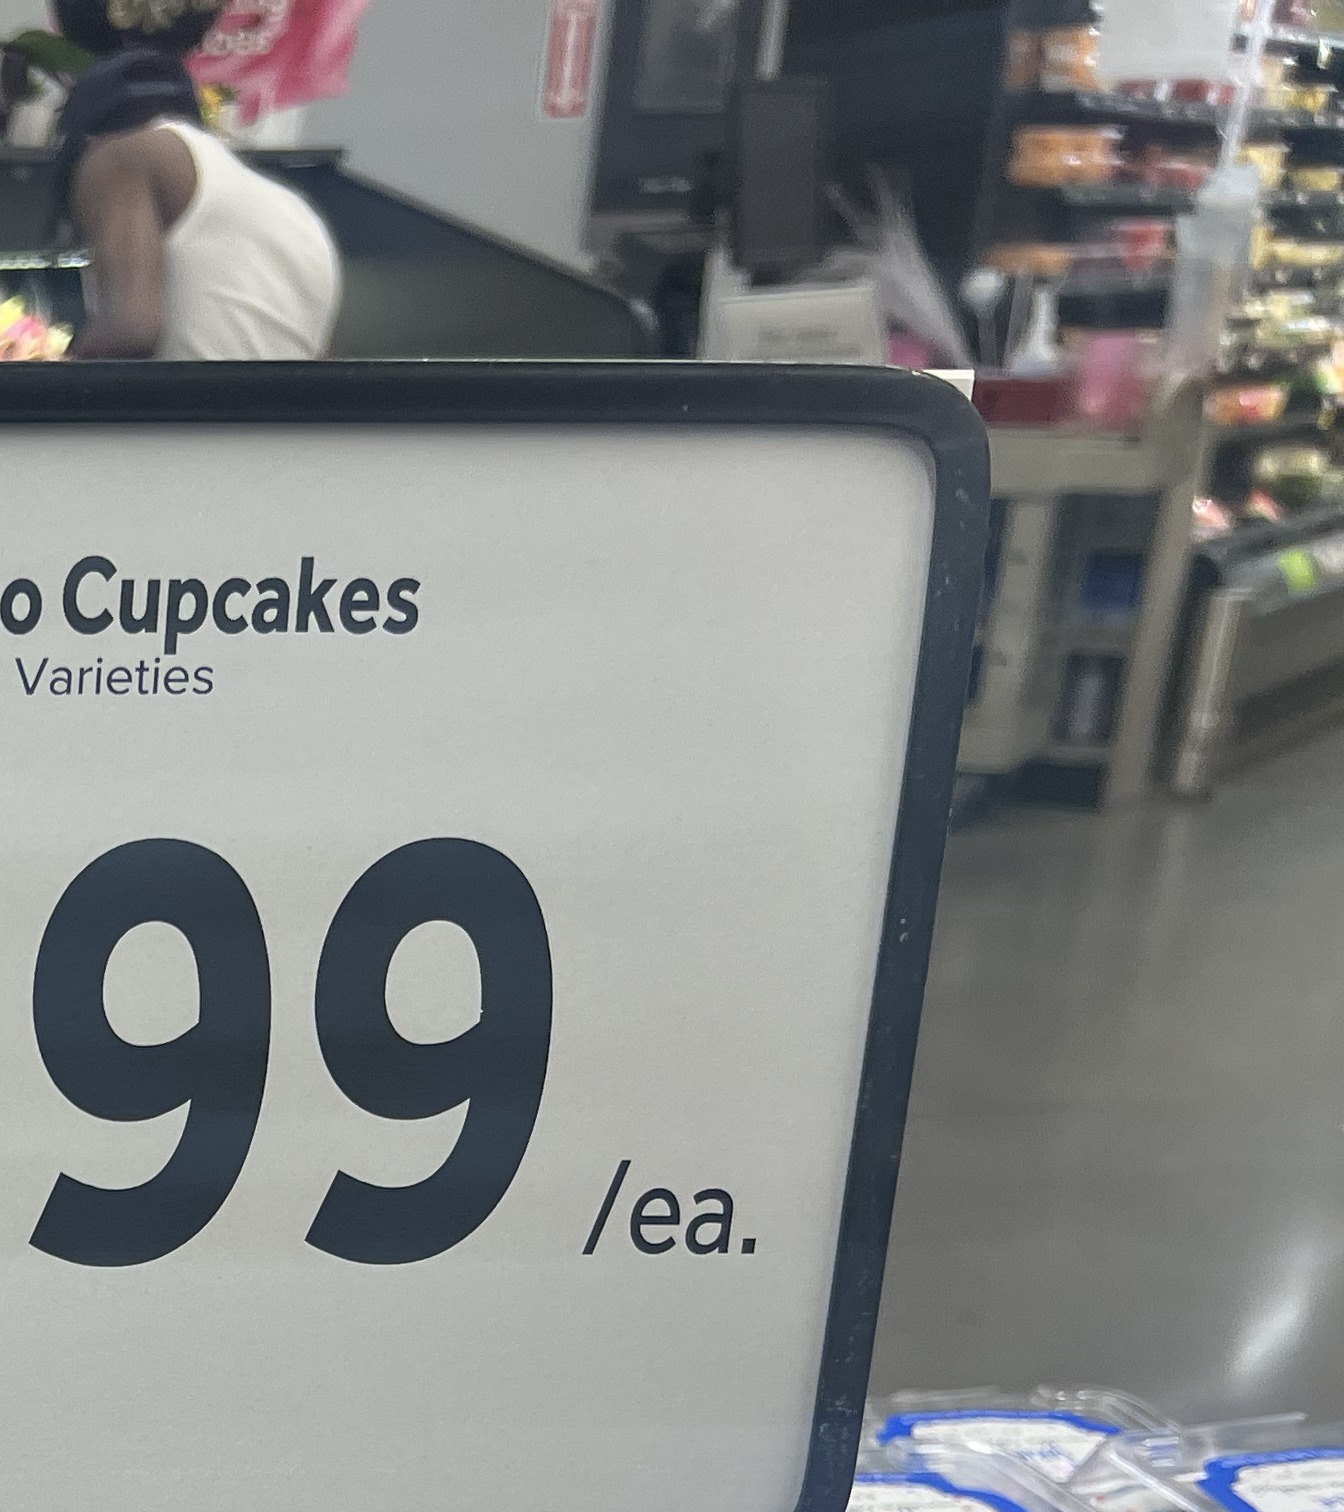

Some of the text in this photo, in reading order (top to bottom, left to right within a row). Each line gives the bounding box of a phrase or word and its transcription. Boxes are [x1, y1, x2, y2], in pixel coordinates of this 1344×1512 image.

[63, 555, 422, 656] Cupcakes
[15, 656, 215, 697] Varieties
[580, 1158, 759, 1258] /ea.
